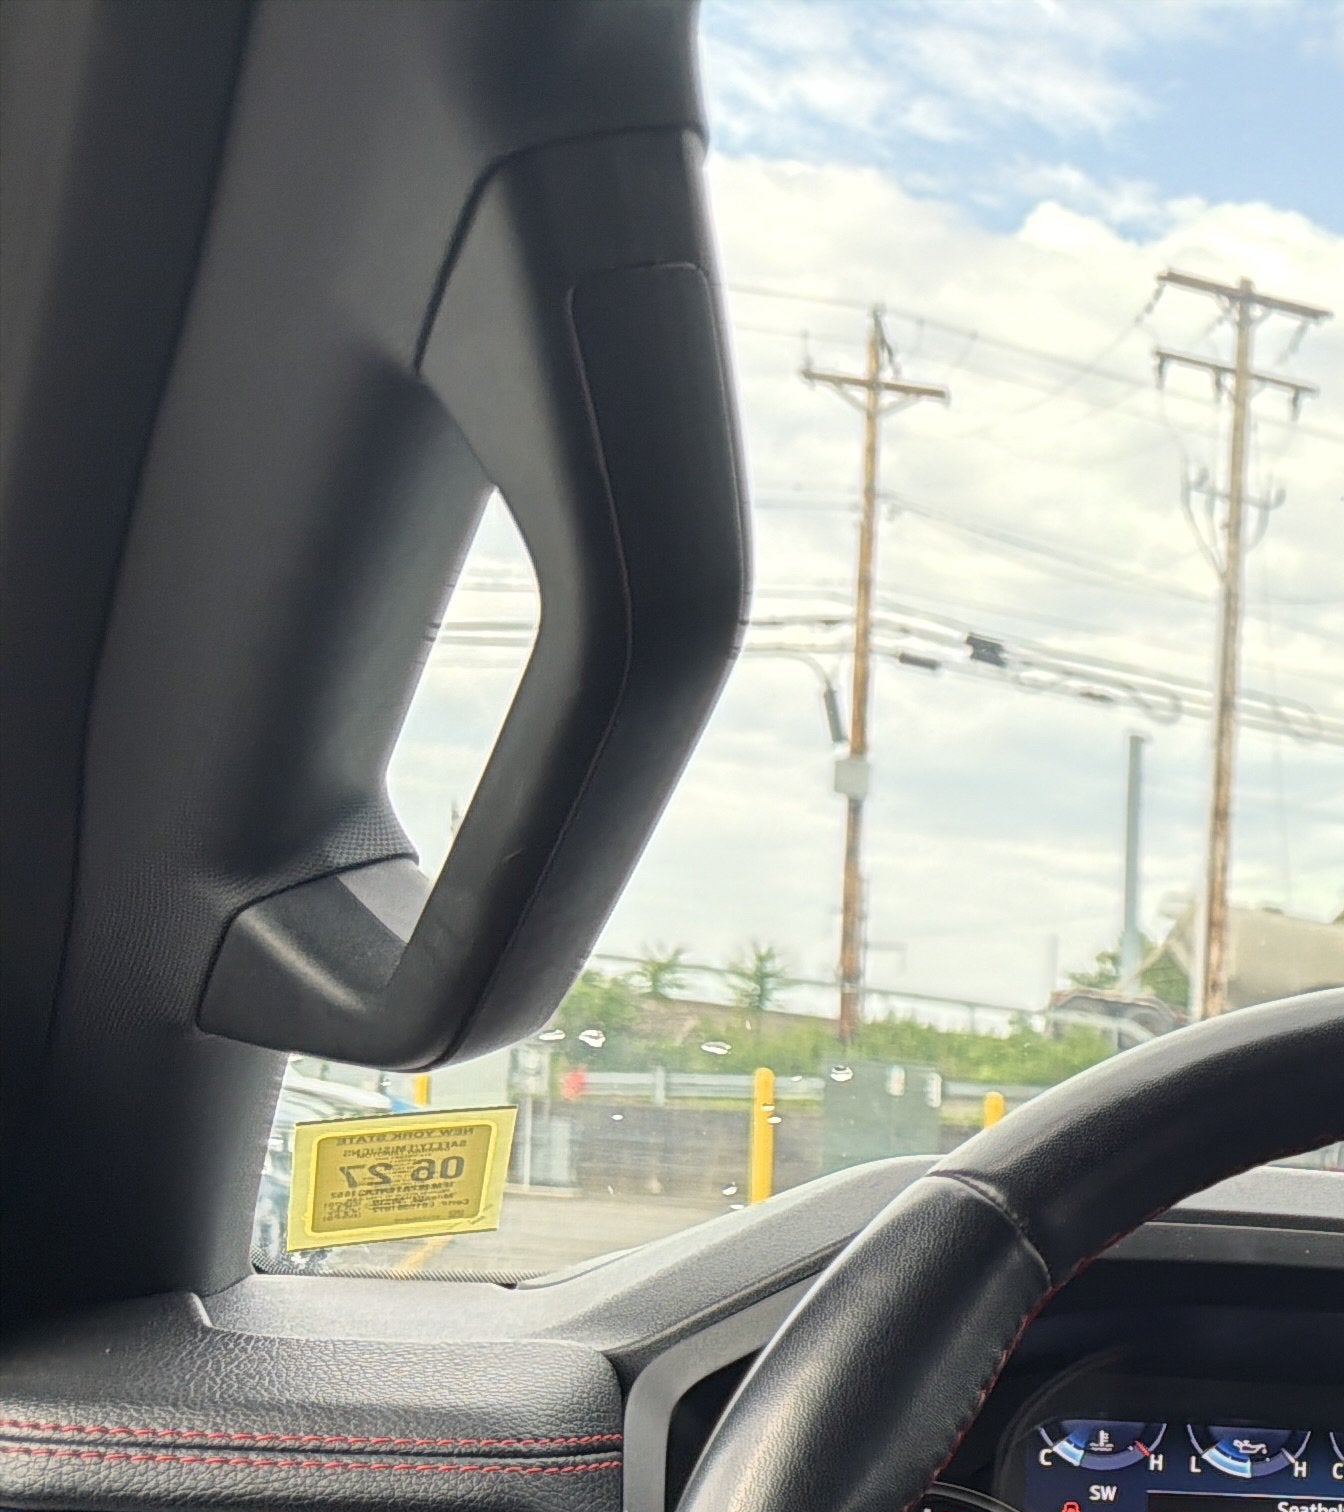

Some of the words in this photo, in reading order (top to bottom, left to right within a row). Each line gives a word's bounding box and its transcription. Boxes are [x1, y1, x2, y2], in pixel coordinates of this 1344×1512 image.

[1039, 1448, 1052, 1466] C
[1150, 1454, 1163, 1471] H
[1190, 1457, 1201, 1473] L
[1294, 1461, 1307, 1478] H
[1332, 1463, 1344, 1480] C
[1088, 1485, 1117, 1501] SW
